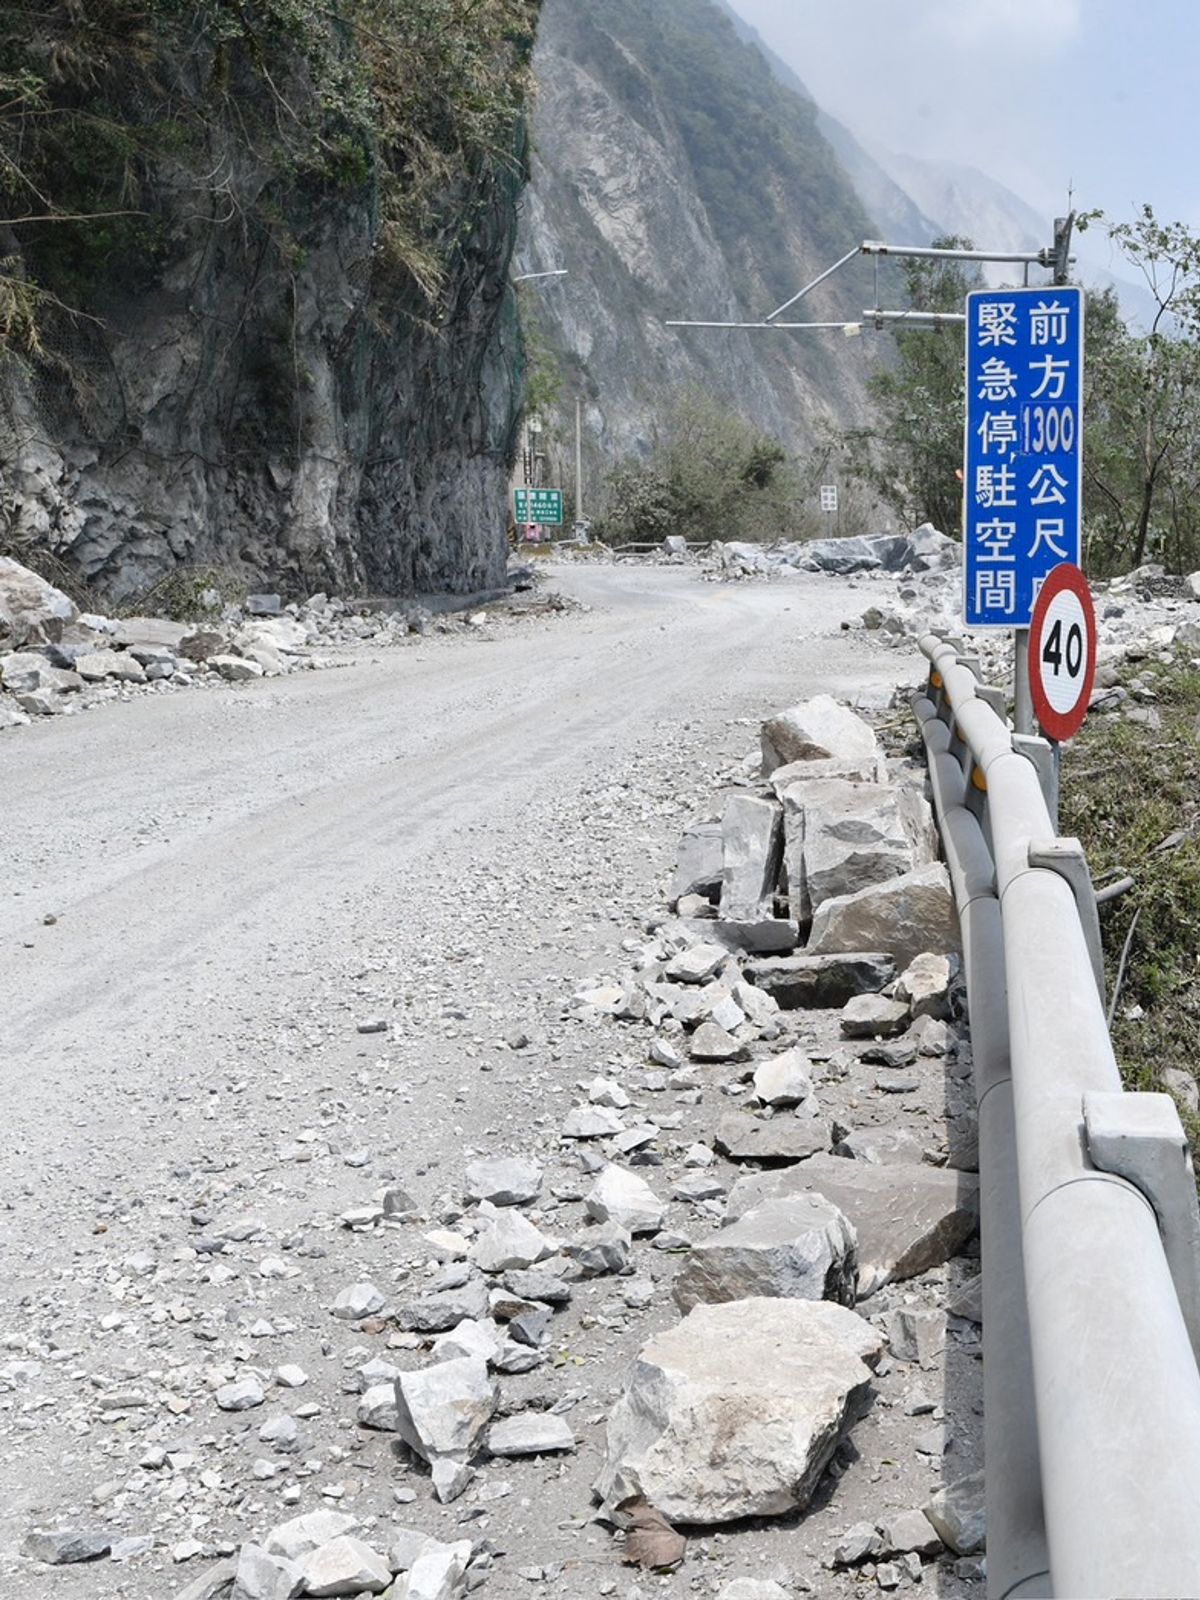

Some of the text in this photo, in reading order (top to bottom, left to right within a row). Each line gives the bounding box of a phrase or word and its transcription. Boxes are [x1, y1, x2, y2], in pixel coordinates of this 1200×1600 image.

[975, 302, 1018, 615] 緊急停駐空間
[1023, 300, 1074, 613] 前方1300公尺
[1043, 619, 1082, 679] 40
